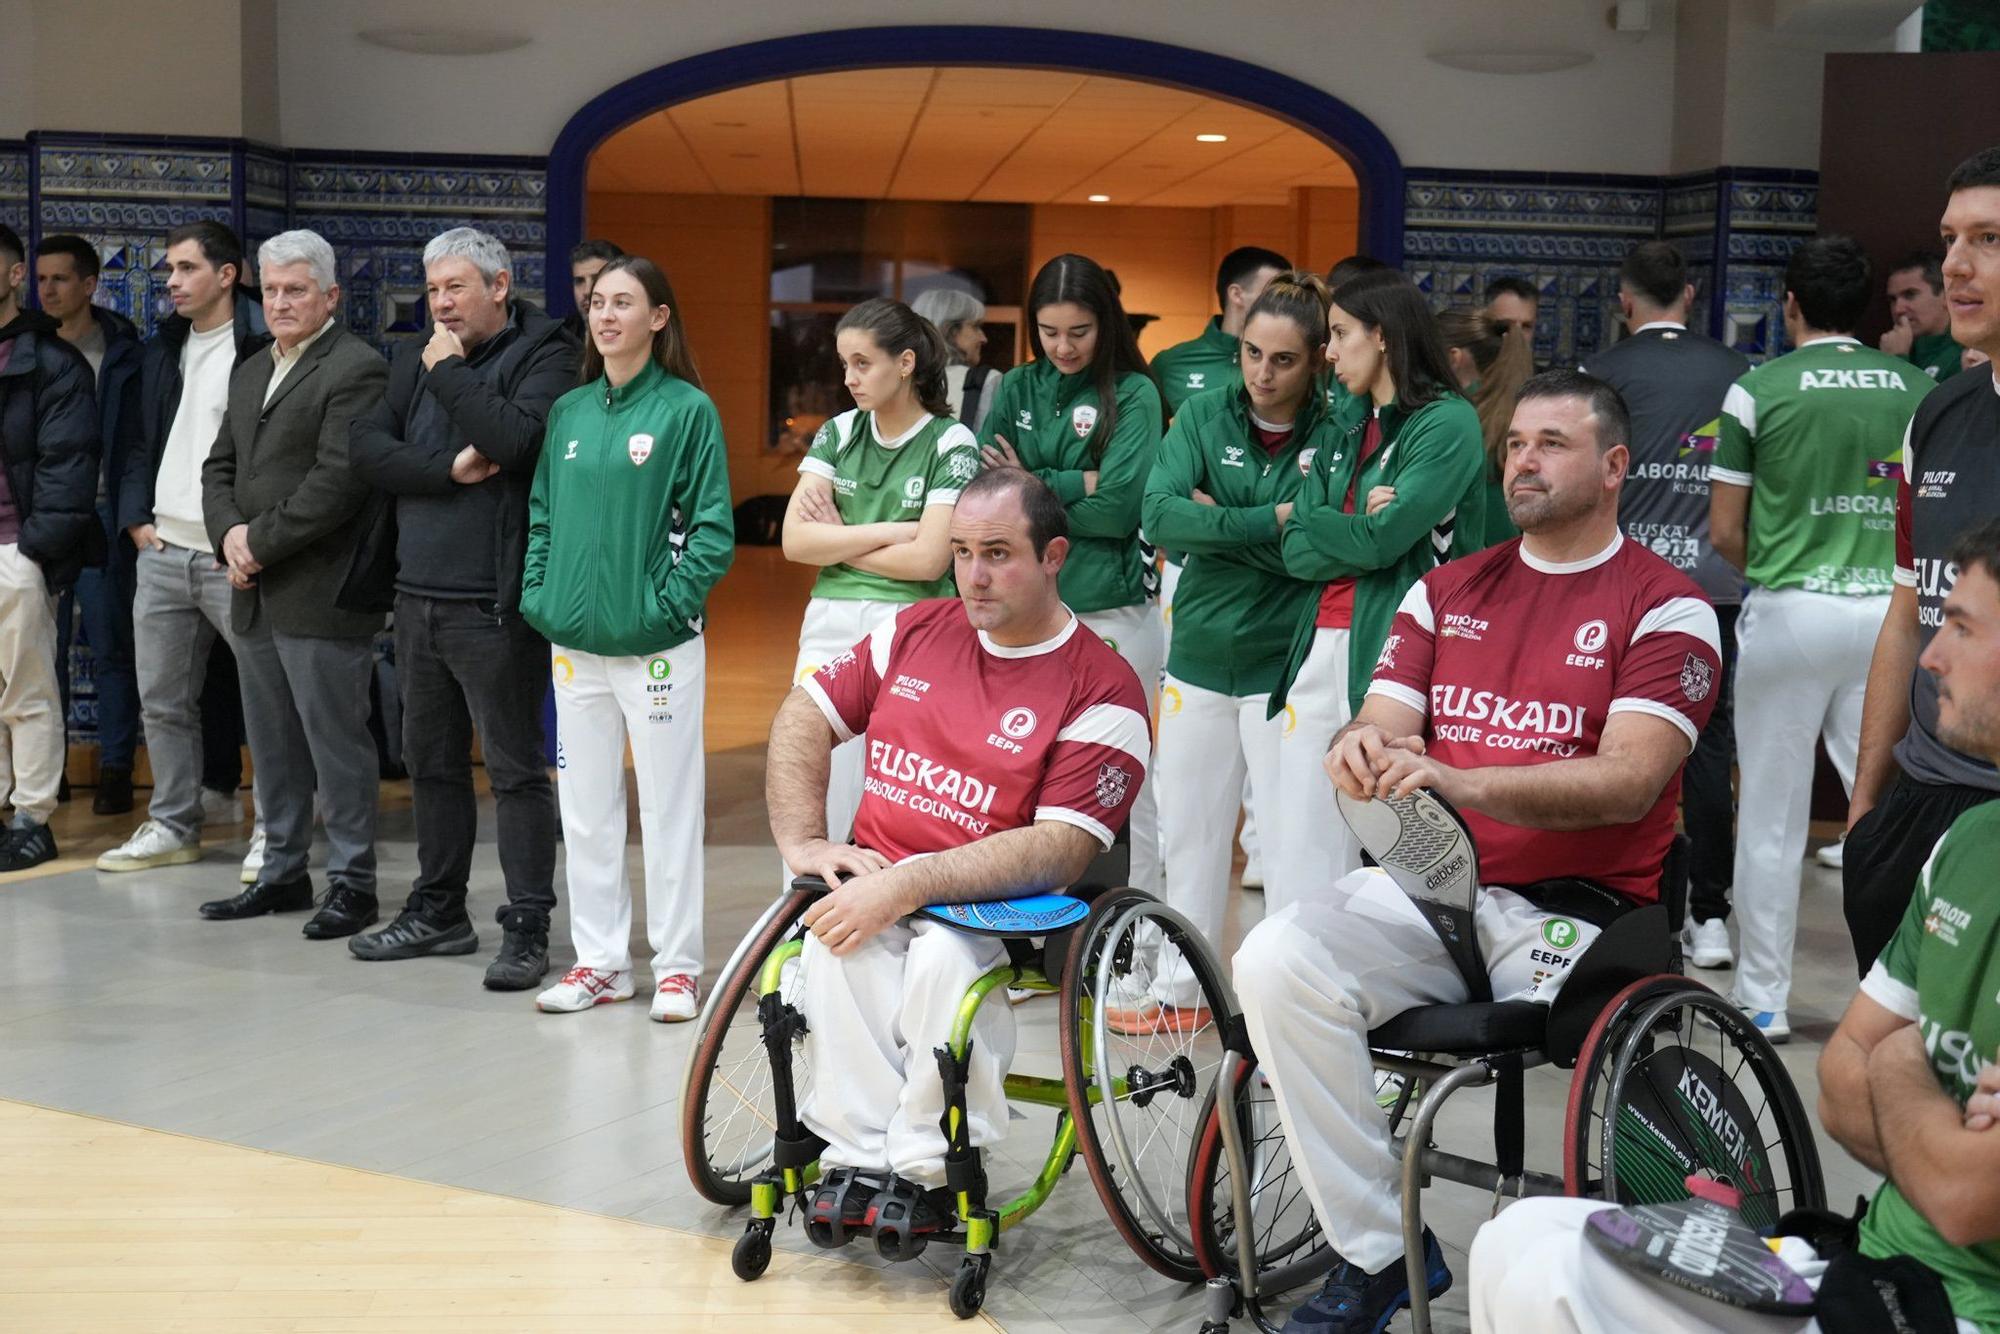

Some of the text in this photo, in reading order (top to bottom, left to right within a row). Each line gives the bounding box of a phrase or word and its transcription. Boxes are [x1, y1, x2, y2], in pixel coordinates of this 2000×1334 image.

[1799, 369, 1907, 392] AZKETA
[1672, 481, 1709, 496] kutxa
[1921, 471, 1956, 485] PILOTA
[1809, 495, 1896, 516] LABORA
[1565, 653, 1605, 670] EEPF
[646, 683, 673, 692] EEPF
[895, 675, 931, 693] PILOTA
[1431, 684, 1587, 739] EUSKADI
[986, 733, 1024, 755] EEPF
[1485, 733, 1580, 758] COUNTRY
[870, 739, 998, 815] EUSKADI
[909, 794, 989, 835] COUNTRY
[1426, 855, 1464, 890] dabber
[1930, 897, 1972, 930] PILOTA
[1530, 949, 1572, 969] EEPF
[1677, 1065, 1752, 1171] KEMEN
[1627, 1102, 1692, 1169] www.kemen.org
